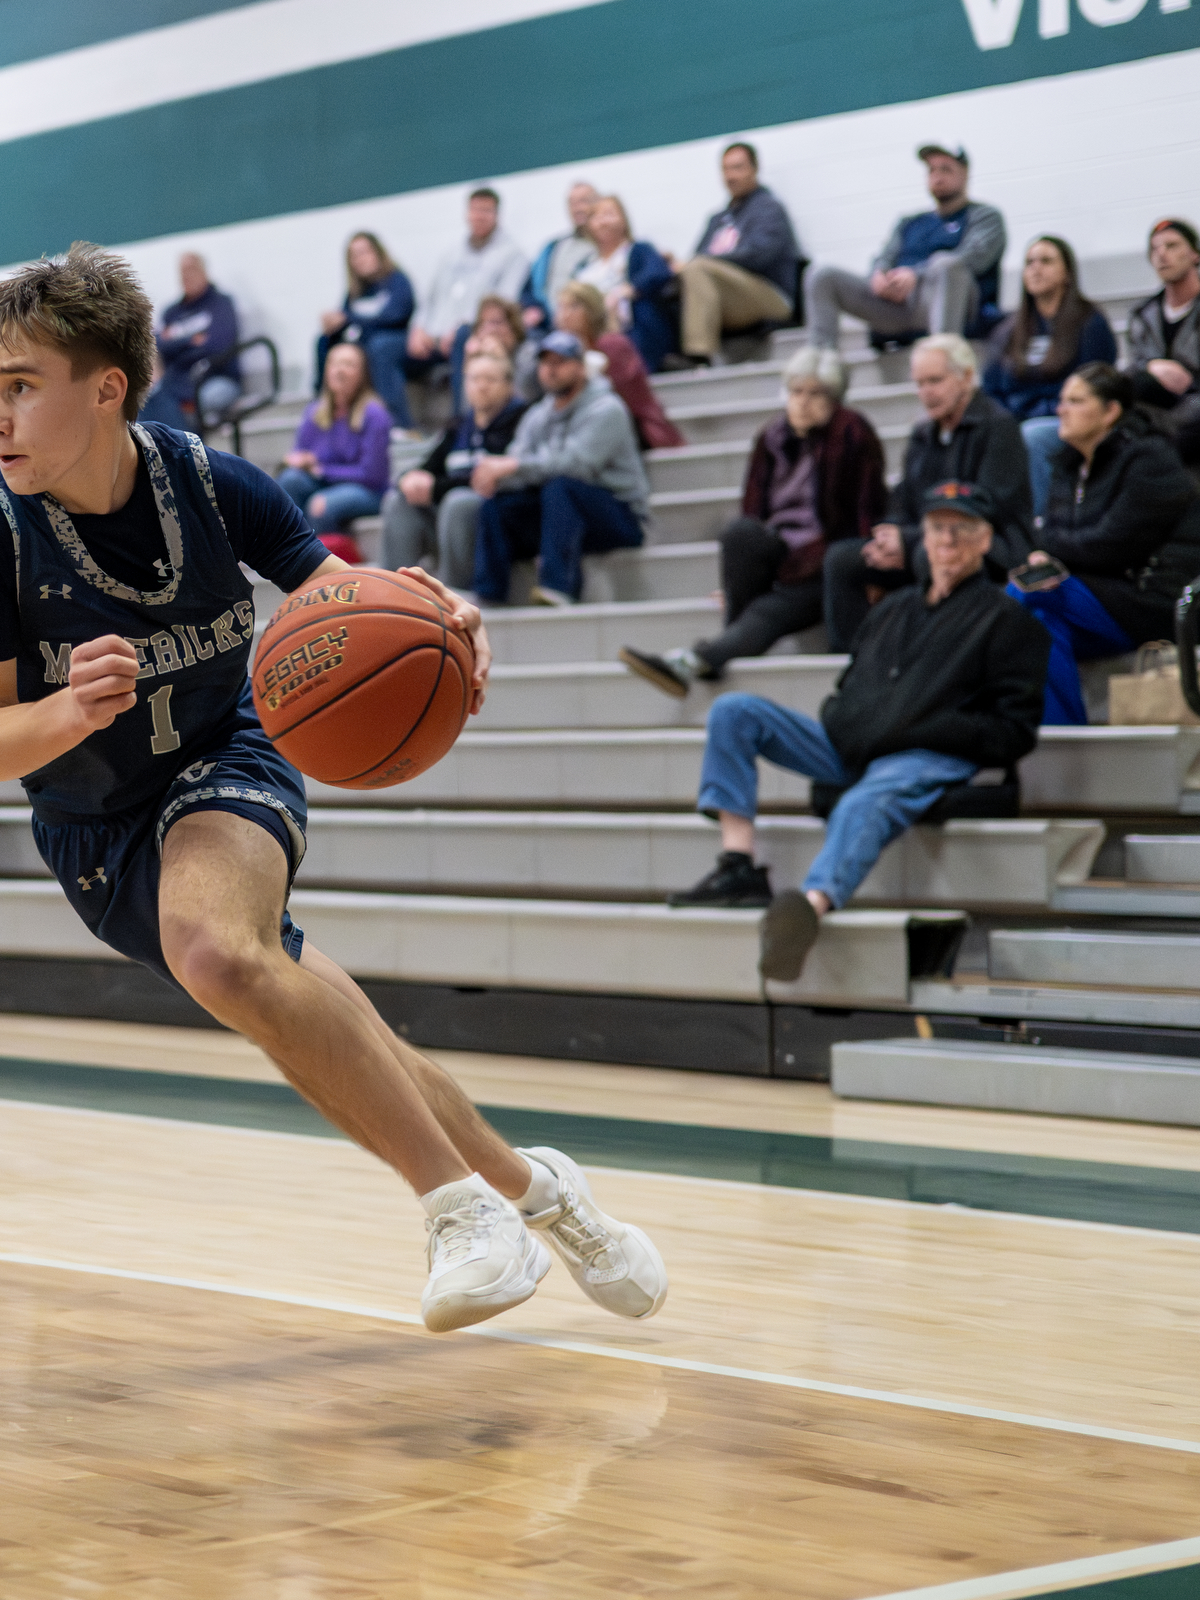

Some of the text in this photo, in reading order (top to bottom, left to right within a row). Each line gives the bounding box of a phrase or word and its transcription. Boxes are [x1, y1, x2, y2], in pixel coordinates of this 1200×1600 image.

[39, 600, 254, 685] MERICKS
[255, 626, 349, 700] LEGACY
[147, 684, 181, 755] 1
